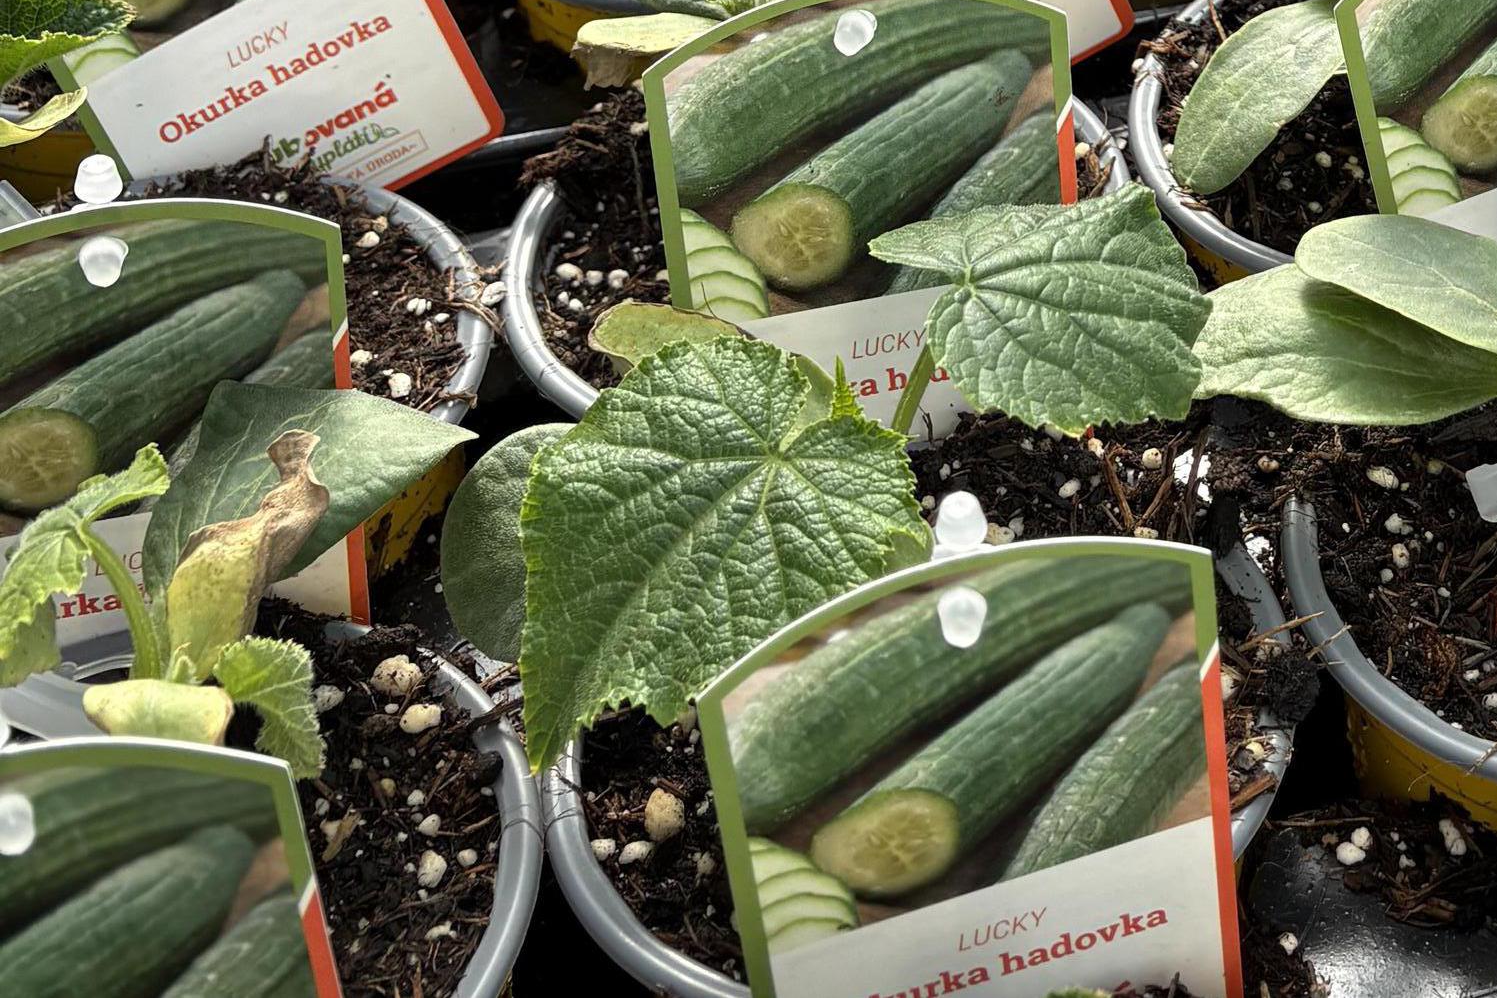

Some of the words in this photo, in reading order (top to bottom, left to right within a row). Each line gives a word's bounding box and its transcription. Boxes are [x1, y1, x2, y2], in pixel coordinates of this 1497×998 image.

[226, 20, 290, 68] LUCKY
[158, 78, 269, 144] Okurka
[266, 14, 393, 87] hadovka
[852, 327, 927, 360] LUCKY
[56, 593, 123, 620] rka
[958, 906, 1048, 952] LUCKY
[997, 907, 1169, 976] hadovka
